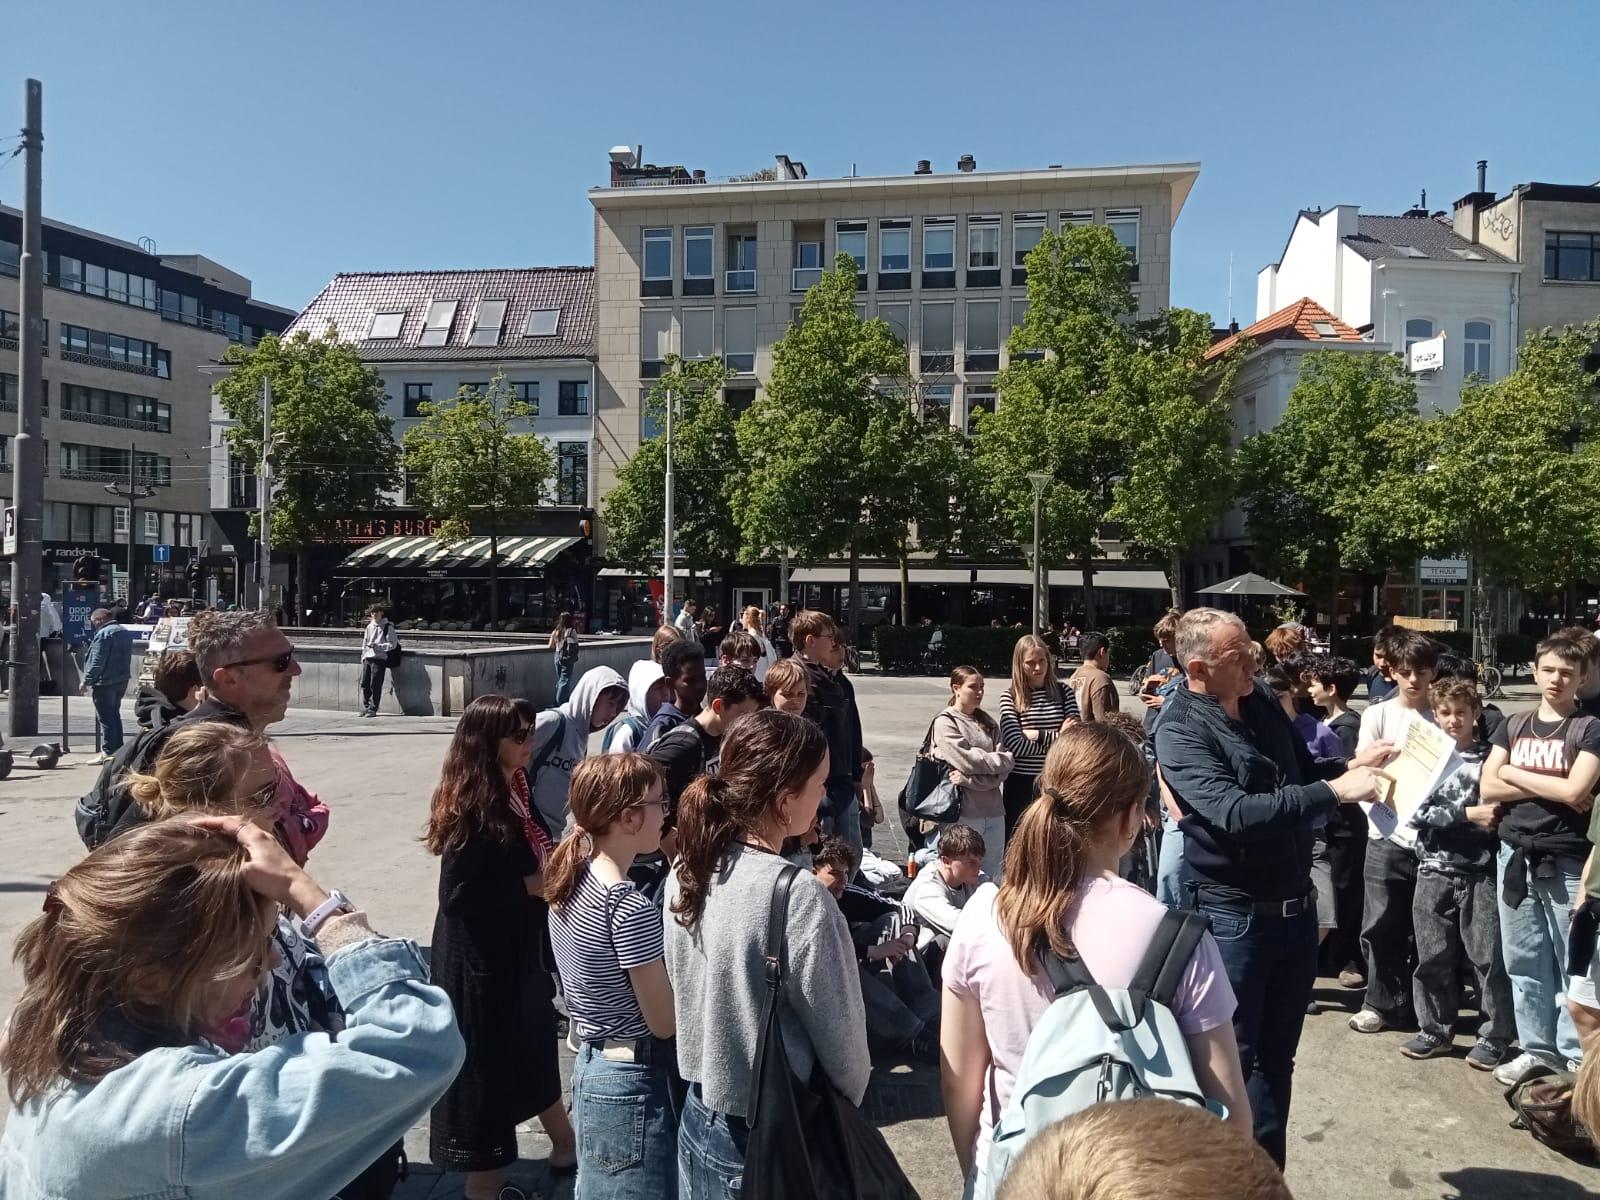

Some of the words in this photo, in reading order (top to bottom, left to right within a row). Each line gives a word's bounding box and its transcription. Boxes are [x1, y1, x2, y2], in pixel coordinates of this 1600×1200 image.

[393, 519, 472, 536] BURGS
[68, 606, 92, 615] DROP
[1510, 737, 1569, 770] MARVE
